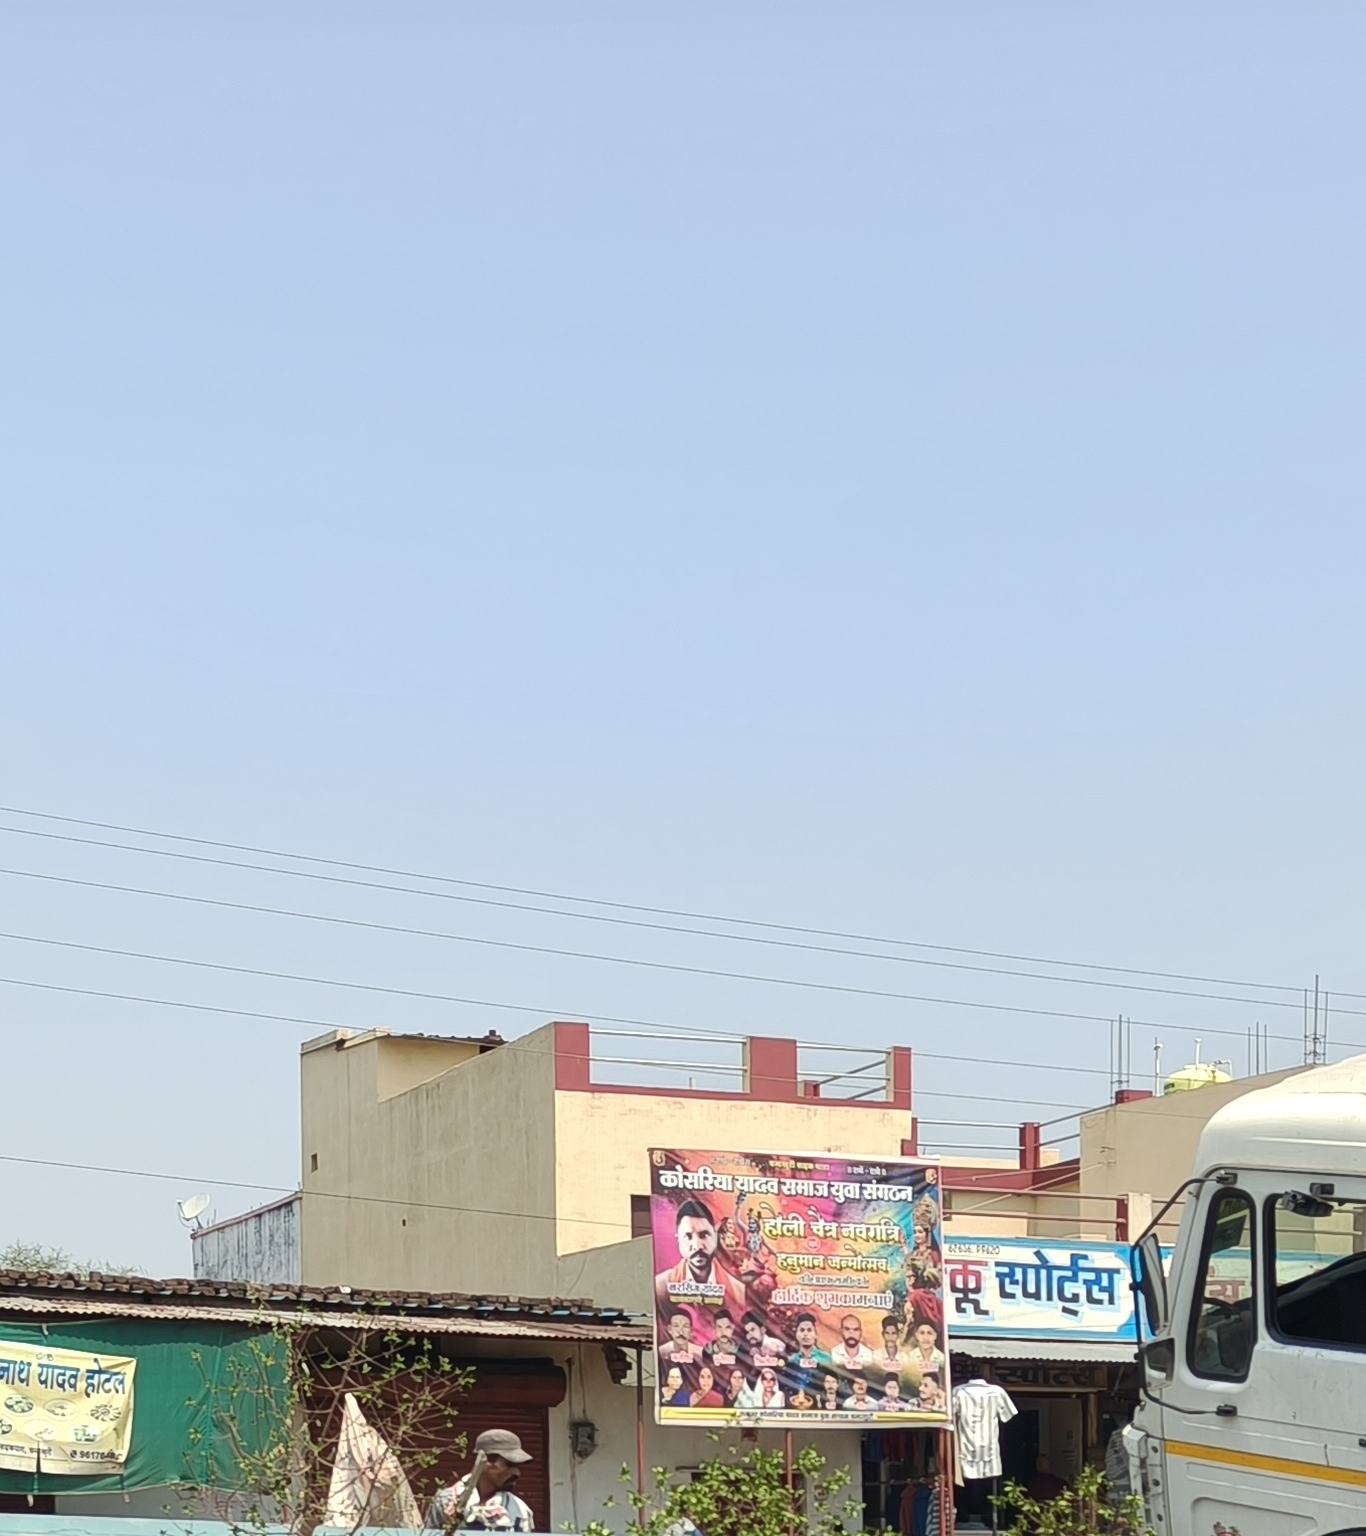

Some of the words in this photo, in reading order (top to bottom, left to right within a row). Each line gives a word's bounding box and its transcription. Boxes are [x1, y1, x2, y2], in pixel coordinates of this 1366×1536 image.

[735, 1175, 779, 1195] यादव
[781, 1178, 828, 1198] समाज
[830, 1181, 861, 1204] युवा
[862, 1179, 913, 1203] संगठन
[762, 1203, 806, 1239] होली
[840, 1216, 901, 1242] नवरात्रि
[776, 1252, 825, 1274] हनुमान
[37, 1362, 80, 1393] यादव
[84, 1358, 127, 1399] होटल
